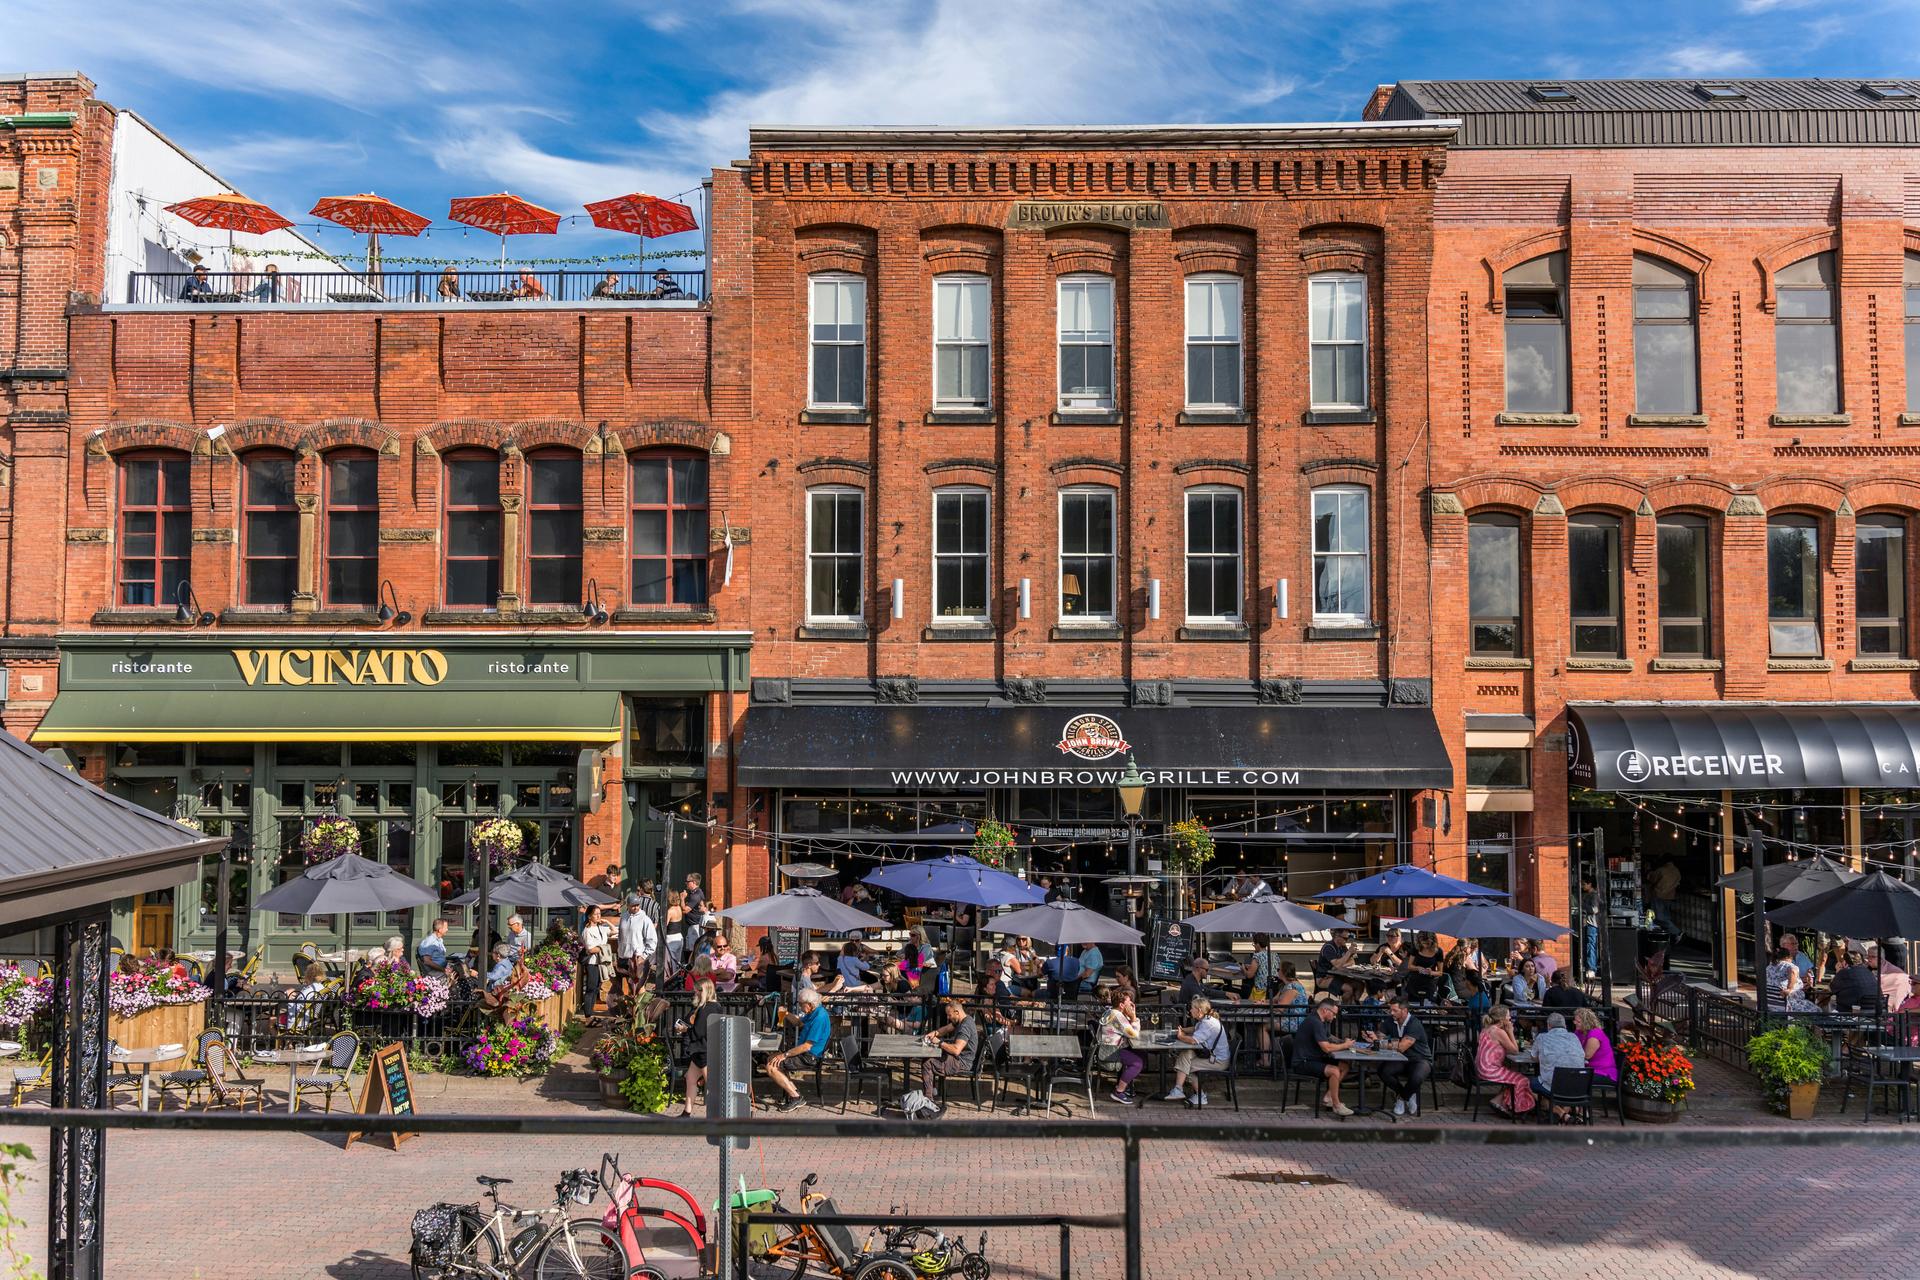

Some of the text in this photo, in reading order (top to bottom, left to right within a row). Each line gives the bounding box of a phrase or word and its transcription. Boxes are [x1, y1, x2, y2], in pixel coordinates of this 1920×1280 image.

[1018, 204, 1161, 221] BROWN'S BLOCK
[111, 660, 193, 674] ristorante
[231, 649, 448, 686] VICINATO
[488, 660, 570, 674] ristorante
[1067, 717, 1119, 739] RICHMOND STREET
[1066, 738, 1121, 748] JOHN BROWN
[1081, 747, 1107, 756] GRILLE
[1653, 754, 1785, 776] RECEIVER
[1882, 761, 1920, 774] CA
[891, 770, 1300, 785] WWW.JOHNBROWGRILLE.COM
